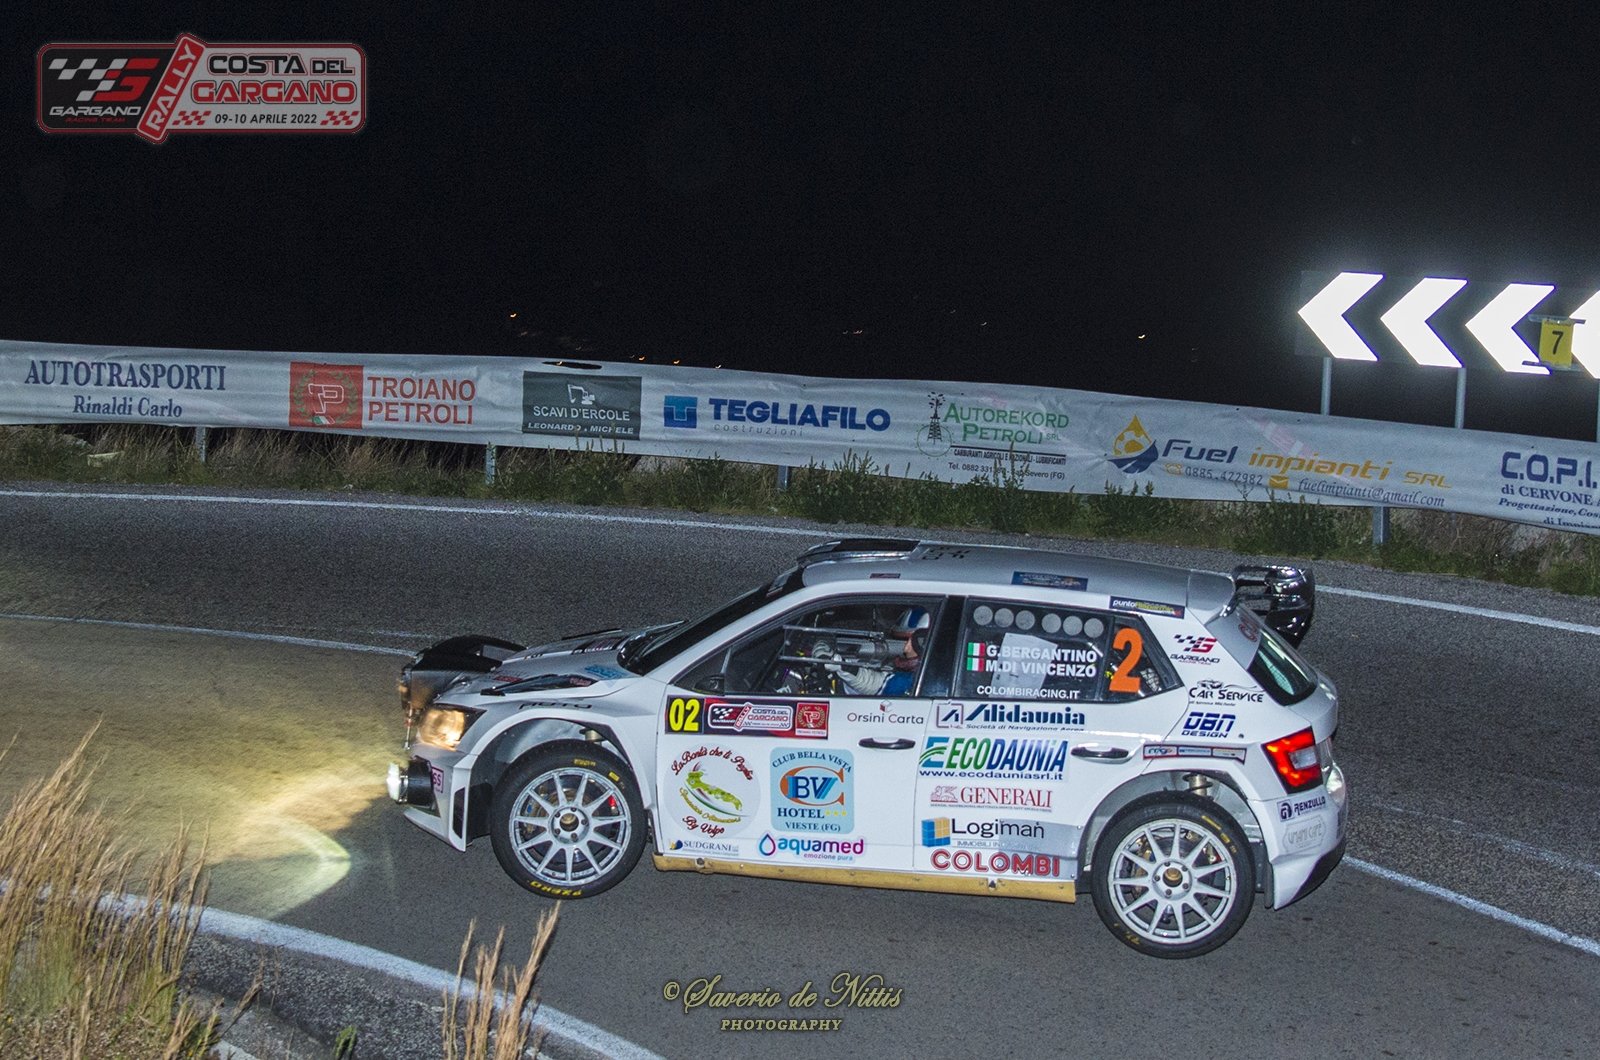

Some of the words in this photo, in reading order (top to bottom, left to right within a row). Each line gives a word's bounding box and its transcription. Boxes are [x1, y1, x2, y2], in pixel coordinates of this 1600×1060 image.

[1552, 330, 1564, 355] 7
[25, 360, 226, 390] AUTOTRASPORTI
[367, 376, 476, 401] TROIANO
[72, 395, 132, 416] Rinaldi
[138, 398, 182, 418] Carlo
[368, 402, 473, 424] PETROLI
[533, 405, 567, 418] SCAVI
[570, 407, 630, 421] D'ERCOLE
[708, 398, 891, 432] TEGLIAFILO
[713, 423, 803, 436] costruzioni
[1046, 432, 1060, 441] SRL
[962, 463, 978, 472] 0882
[1050, 472, 1066, 480] (FG)
[1162, 439, 1239, 463] Fuel
[1248, 447, 1393, 480] impianti
[1404, 471, 1453, 488] SRL
[1501, 451, 1598, 489] C.O.P.I.
[1501, 484, 1515, 495] di
[1519, 485, 1593, 506] CERVONE
[1498, 497, 1577, 516] Progettazione,
[986, 645, 1097, 663] G.BERGANTINO
[1109, 628, 1143, 692] 2
[1170, 654, 1220, 663] GARGANO
[985, 659, 1018, 672] M.DI
[1021, 662, 1097, 678] VINCENZO
[977, 686, 1080, 699] COLOMBIRACING.IT
[1189, 687, 1213, 699] CAR
[1218, 689, 1264, 703] SERVICE
[669, 698, 700, 732] 02
[847, 712, 885, 723] Orsini
[888, 713, 924, 724] Carta
[772, 753, 796, 768] CLUB
[797, 751, 826, 760] BELLA
[828, 754, 852, 773] VISTA
[919, 770, 1063, 780] www.ecodauniasrl.it
[961, 786, 1053, 808] GENERALI
[1294, 796, 1326, 815] RENZULLO
[777, 808, 825, 819] HOTEL
[785, 822, 820, 831] VIESTE
[821, 824, 841, 833] (FG)
[952, 819, 1045, 838] Logiman
[684, 841, 732, 852] SUDGRANI
[778, 837, 864, 856] aquamed
[930, 849, 1061, 877] COLOMBI
